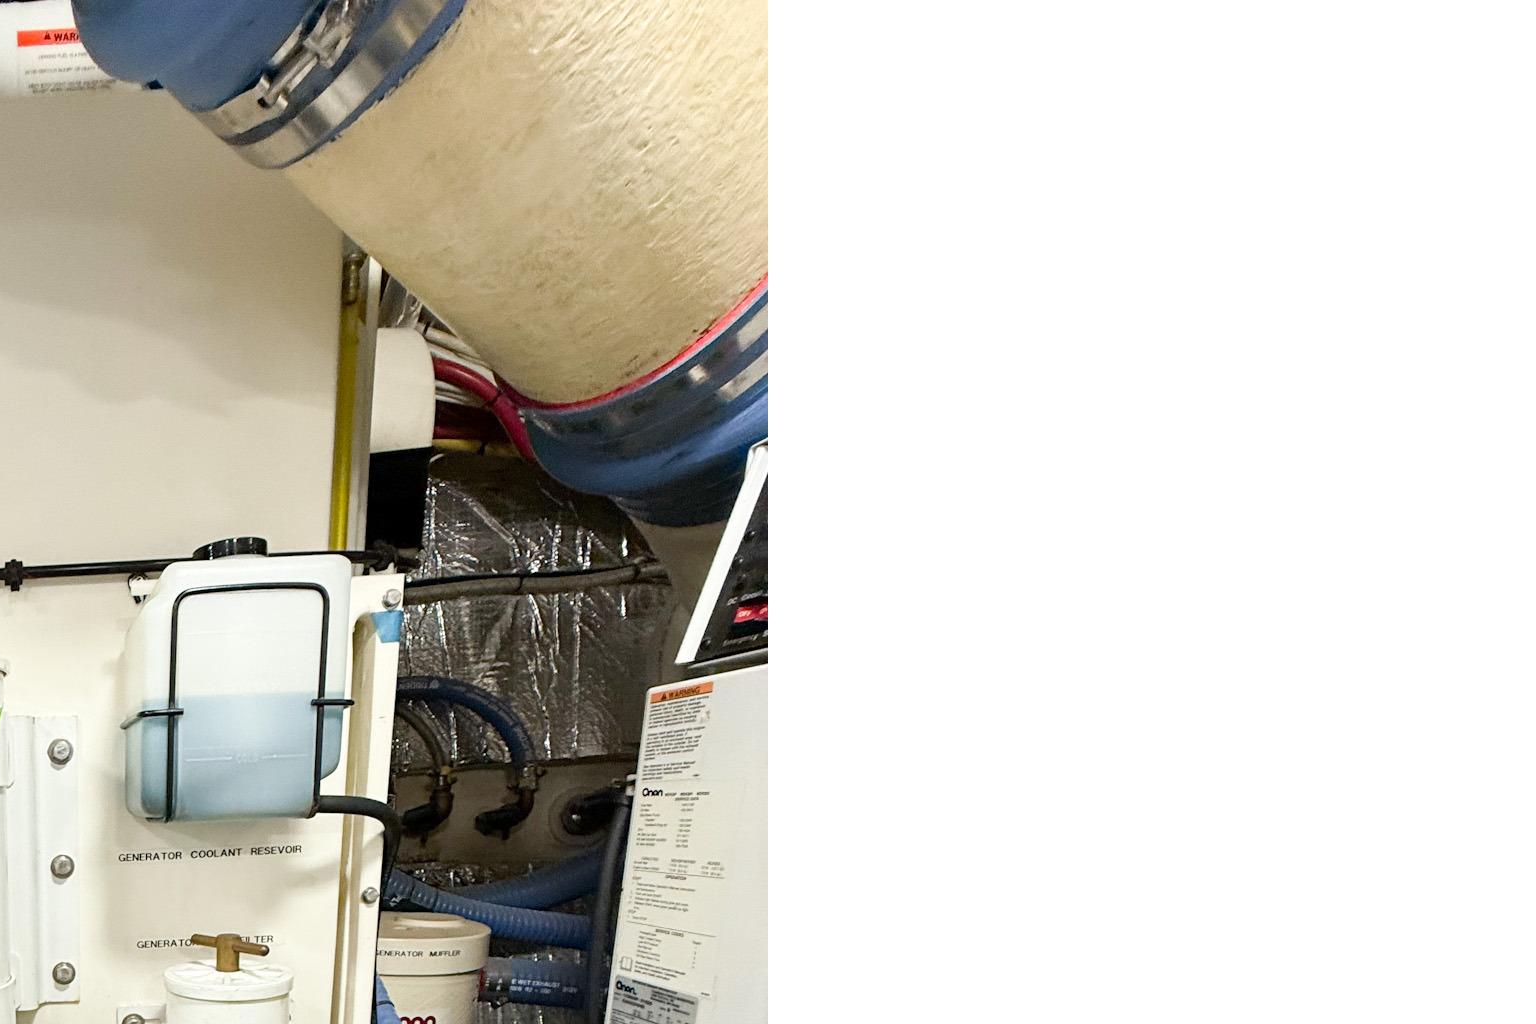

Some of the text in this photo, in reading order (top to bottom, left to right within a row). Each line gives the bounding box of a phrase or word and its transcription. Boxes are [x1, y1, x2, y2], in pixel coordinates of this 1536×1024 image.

[118, 845, 302, 862] GENERATOR COOLANT RESEVOIR
[136, 939, 195, 949] GENERATO
[429, 950, 462, 958] MUFFLER
